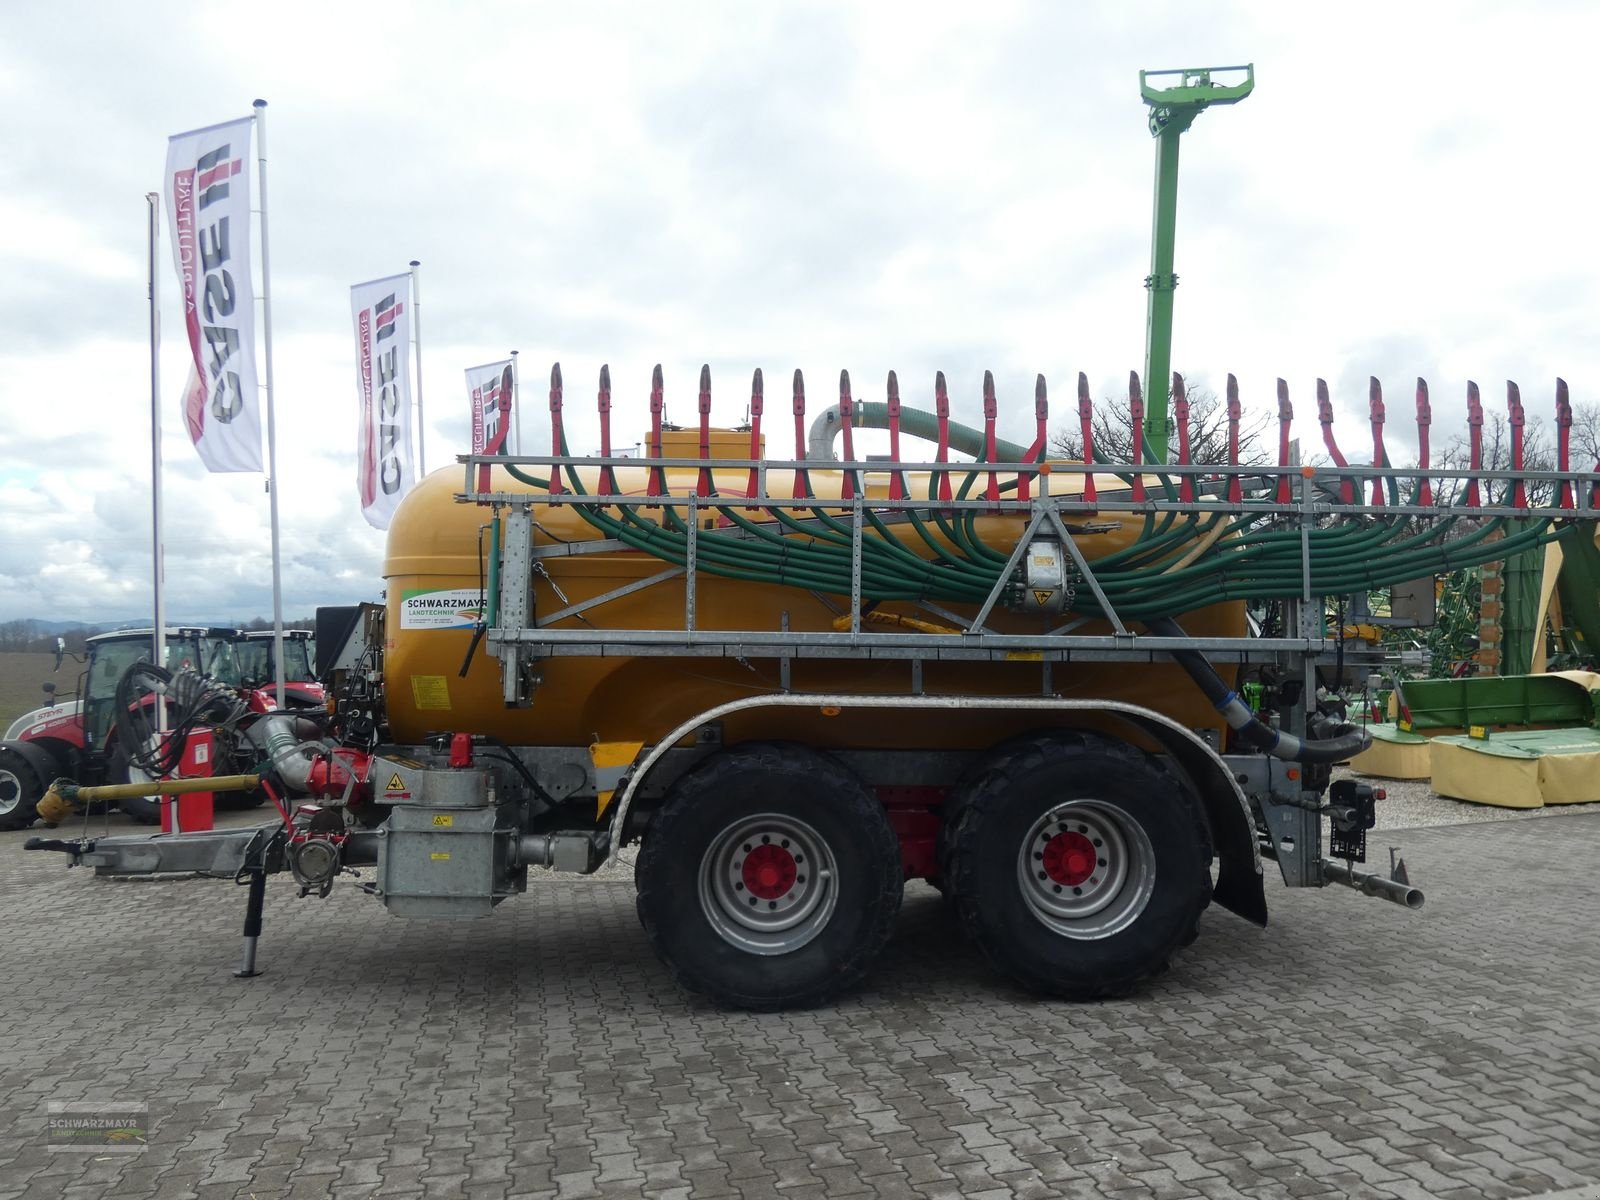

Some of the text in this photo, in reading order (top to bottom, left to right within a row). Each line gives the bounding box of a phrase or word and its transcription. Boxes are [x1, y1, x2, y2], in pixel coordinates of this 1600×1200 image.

[408, 599, 487, 608] SCHWARZMAYR
[409, 609, 455, 617] LANDTECHNIK
[38, 708, 64, 720] STEYR
